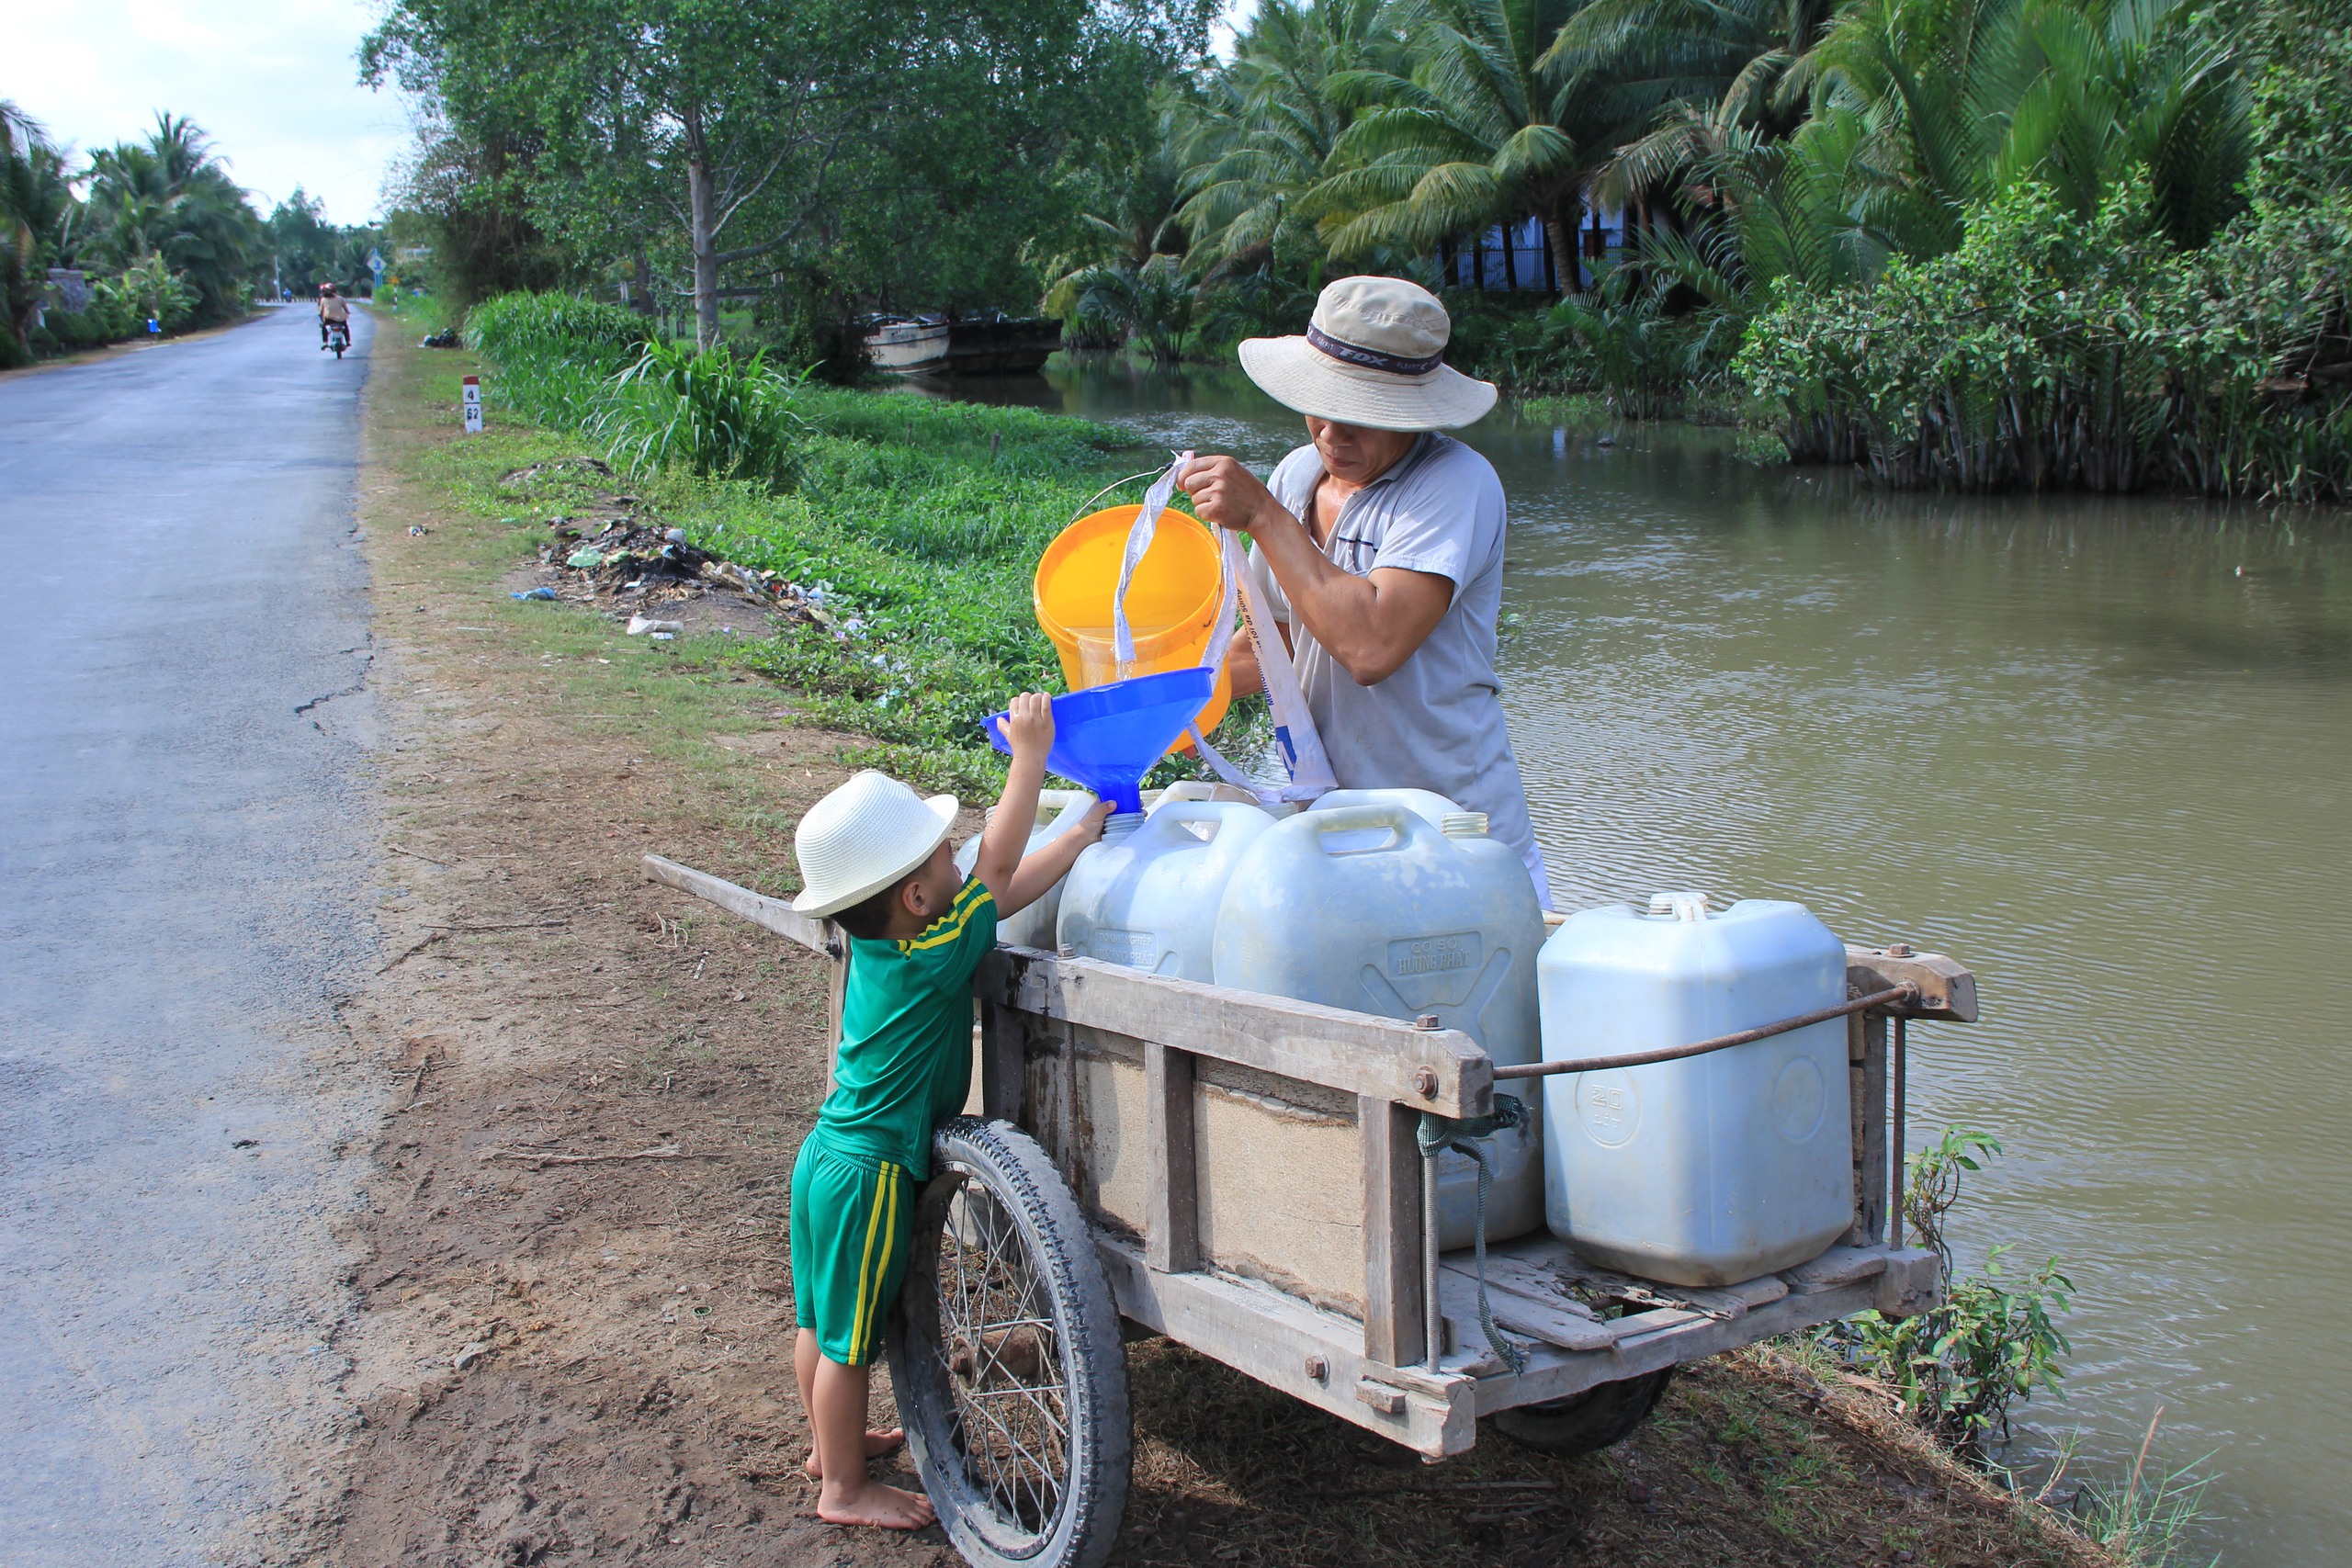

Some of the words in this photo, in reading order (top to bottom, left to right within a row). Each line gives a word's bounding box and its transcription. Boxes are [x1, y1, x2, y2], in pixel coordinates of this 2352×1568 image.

[1340, 346, 1389, 366] FOX
[468, 389, 474, 400] 4
[1130, 950, 1154, 964] PHÁT
[1440, 949, 1470, 970] PHÁT
[1591, 1084, 1622, 1110] 20
